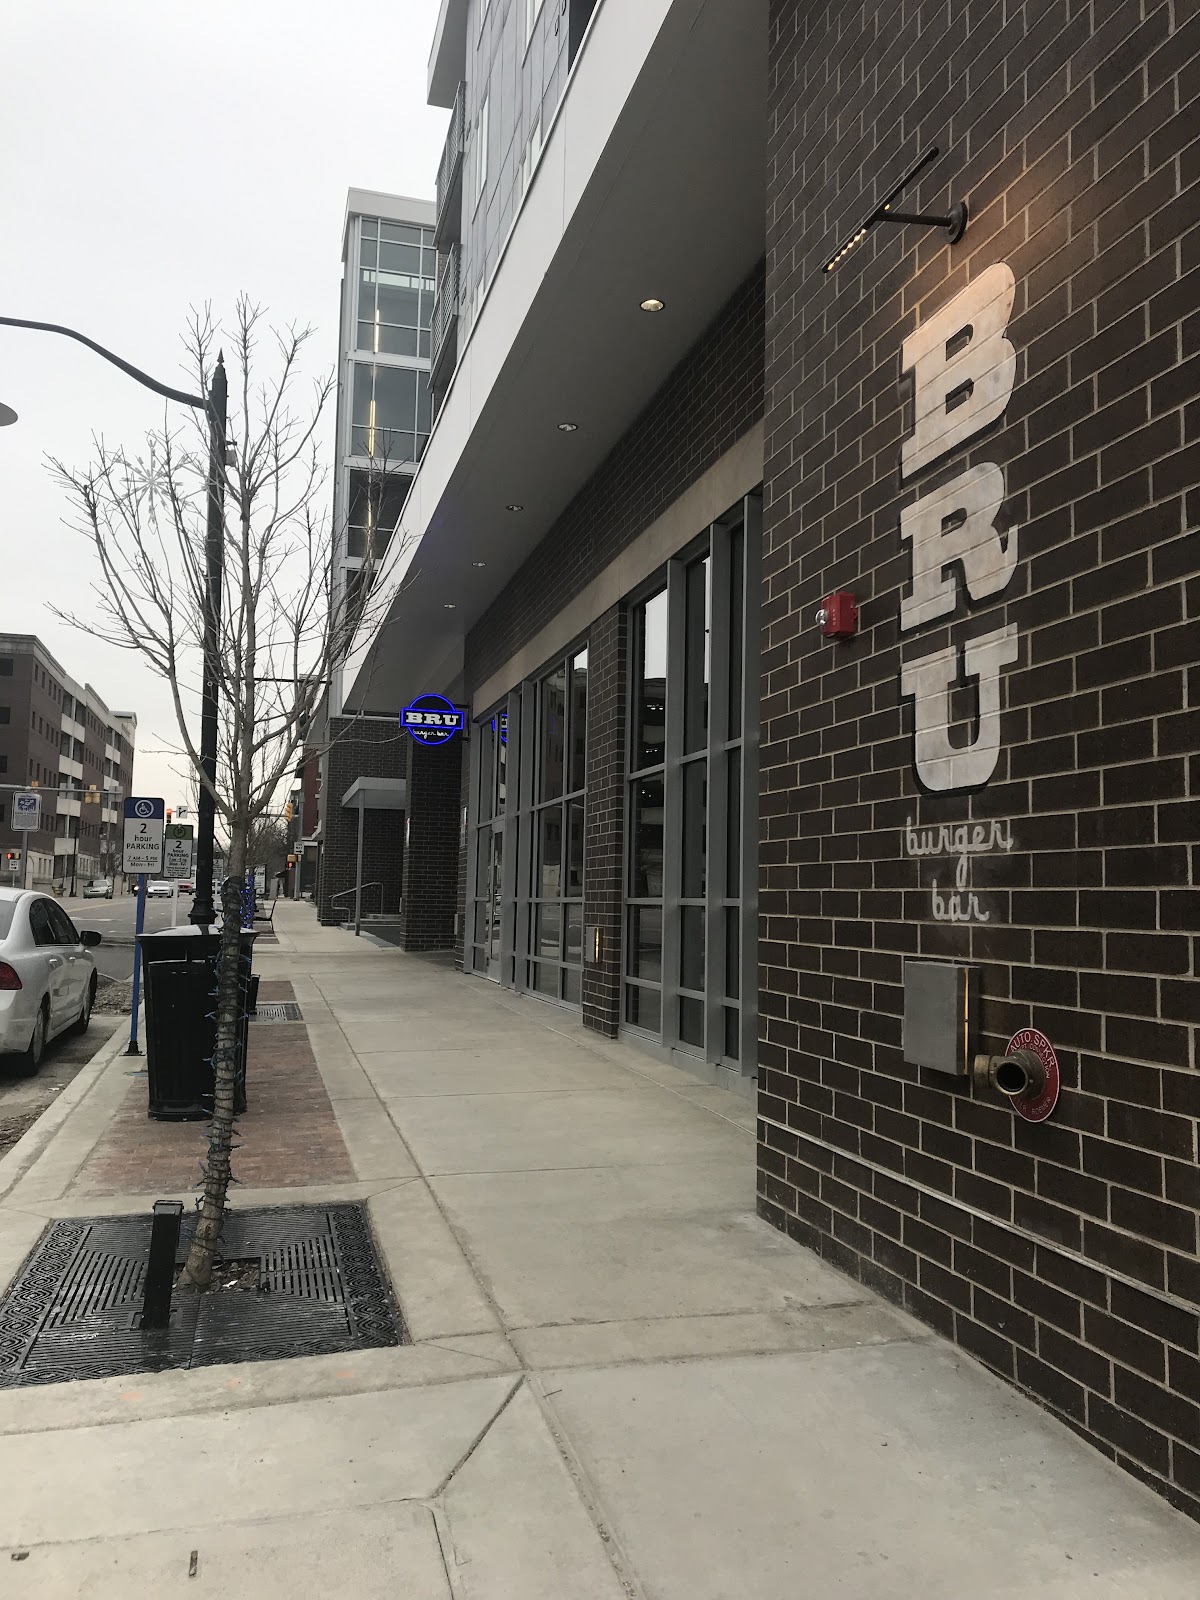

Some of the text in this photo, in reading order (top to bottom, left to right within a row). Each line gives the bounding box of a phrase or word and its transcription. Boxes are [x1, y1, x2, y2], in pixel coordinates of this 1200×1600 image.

[901, 261, 1019, 792] BRU
[405, 712, 459, 726] BRU
[412, 729, 436, 740] burger
[140, 823, 147, 834] 2
[175, 841, 182, 849] 2
[906, 816, 1014, 892] burger
[932, 879, 990, 922] bar
